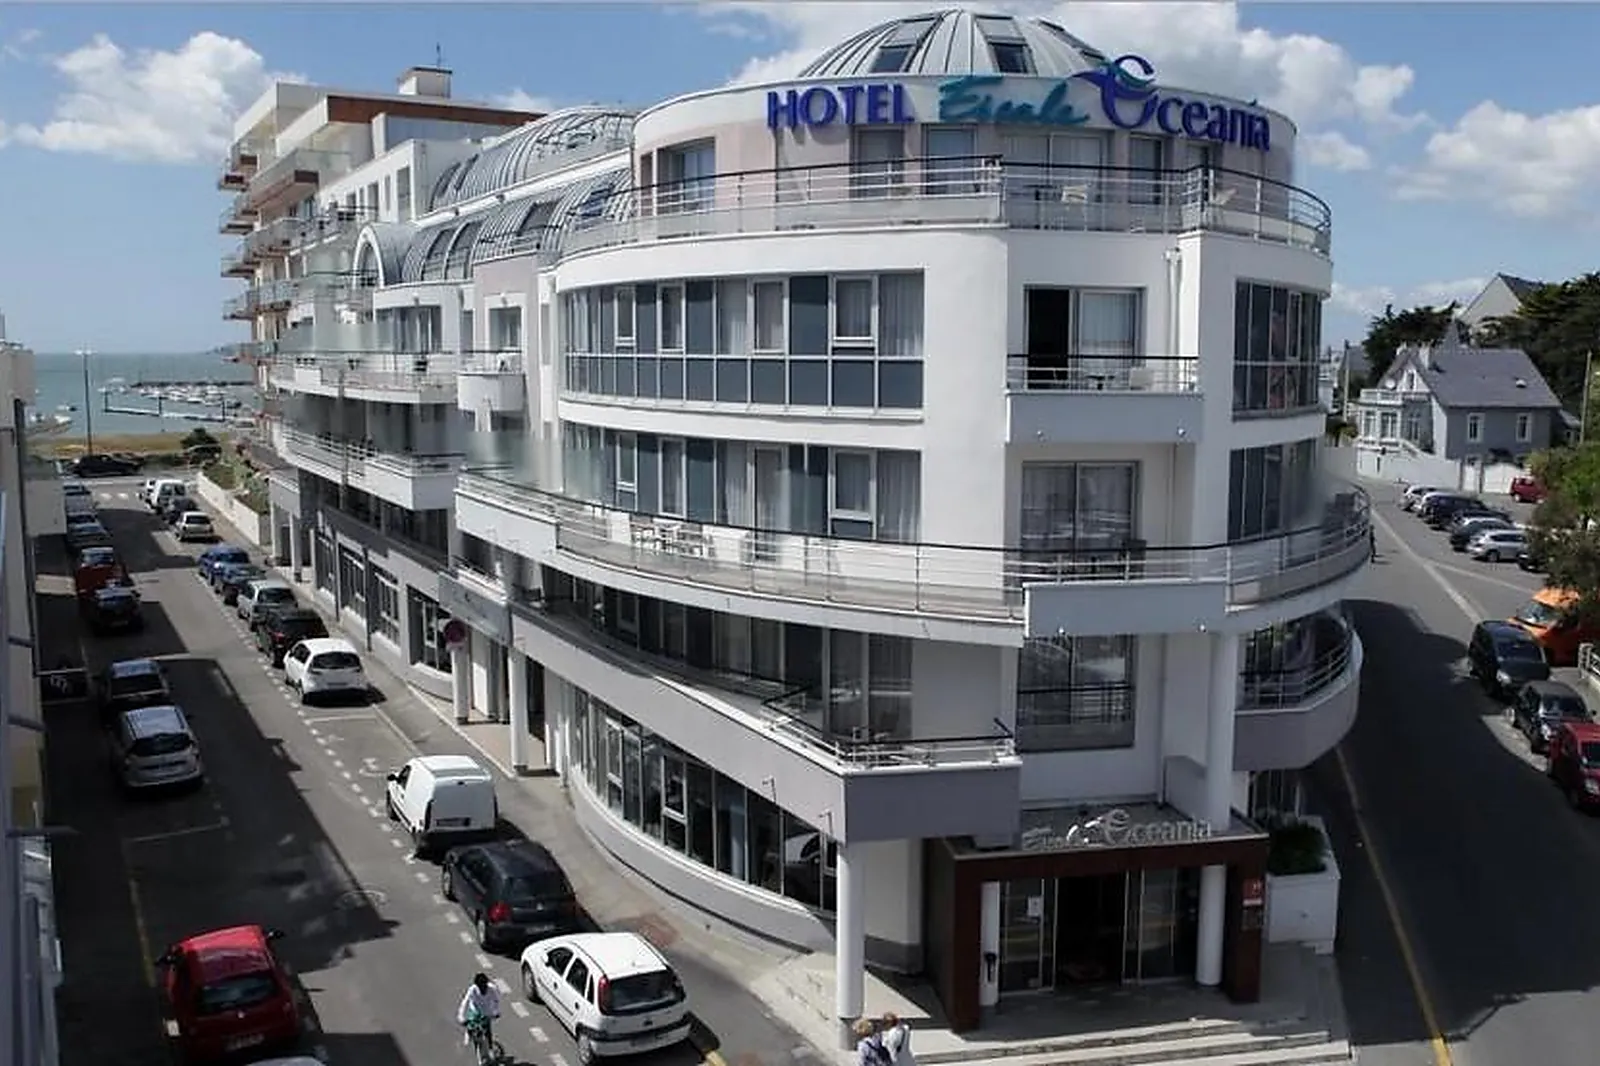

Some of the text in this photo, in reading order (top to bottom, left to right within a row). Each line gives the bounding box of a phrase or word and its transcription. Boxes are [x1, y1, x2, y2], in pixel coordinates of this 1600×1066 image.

[767, 84, 915, 130] HOTEL
[1074, 55, 1270, 151] Oceania
[1086, 808, 1212, 846] Oceania
